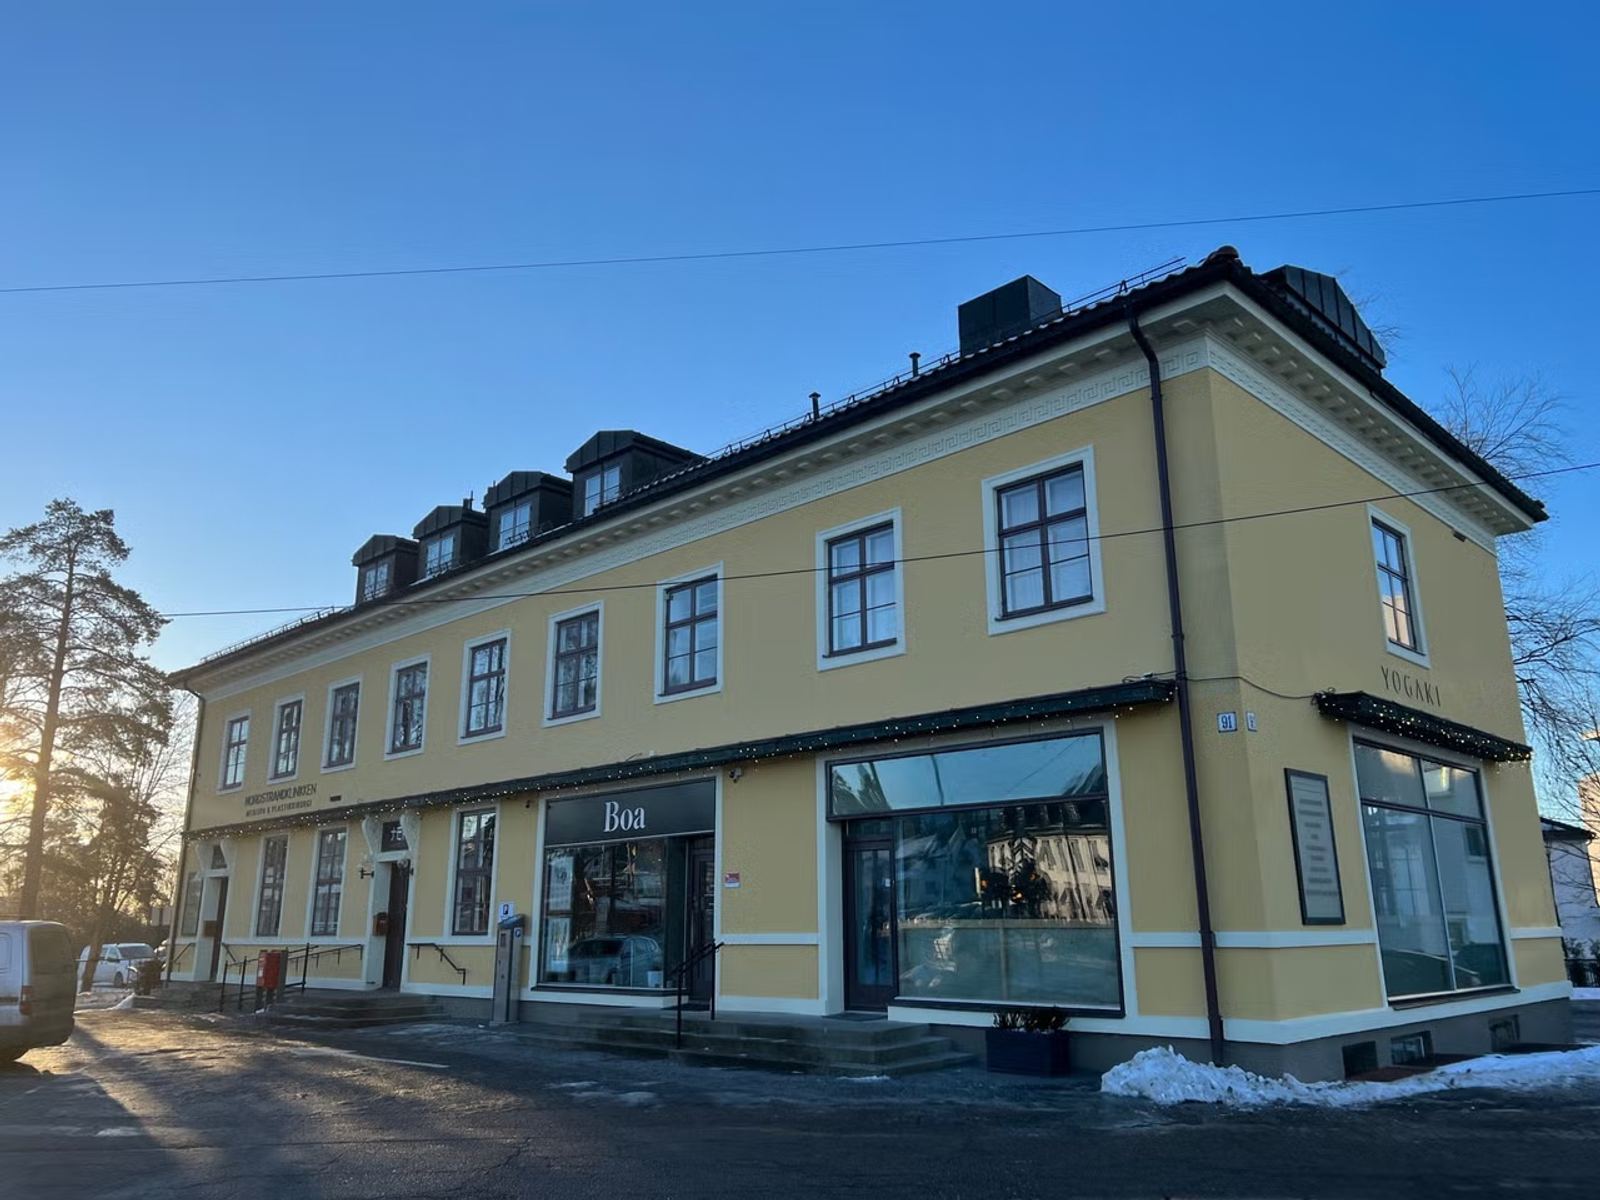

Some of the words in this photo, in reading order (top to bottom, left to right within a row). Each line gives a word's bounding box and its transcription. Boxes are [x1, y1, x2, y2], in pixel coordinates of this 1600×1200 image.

[1381, 665, 1440, 707] YOGAKI
[1221, 715, 1233, 729] 91
[603, 801, 646, 832] Boa
